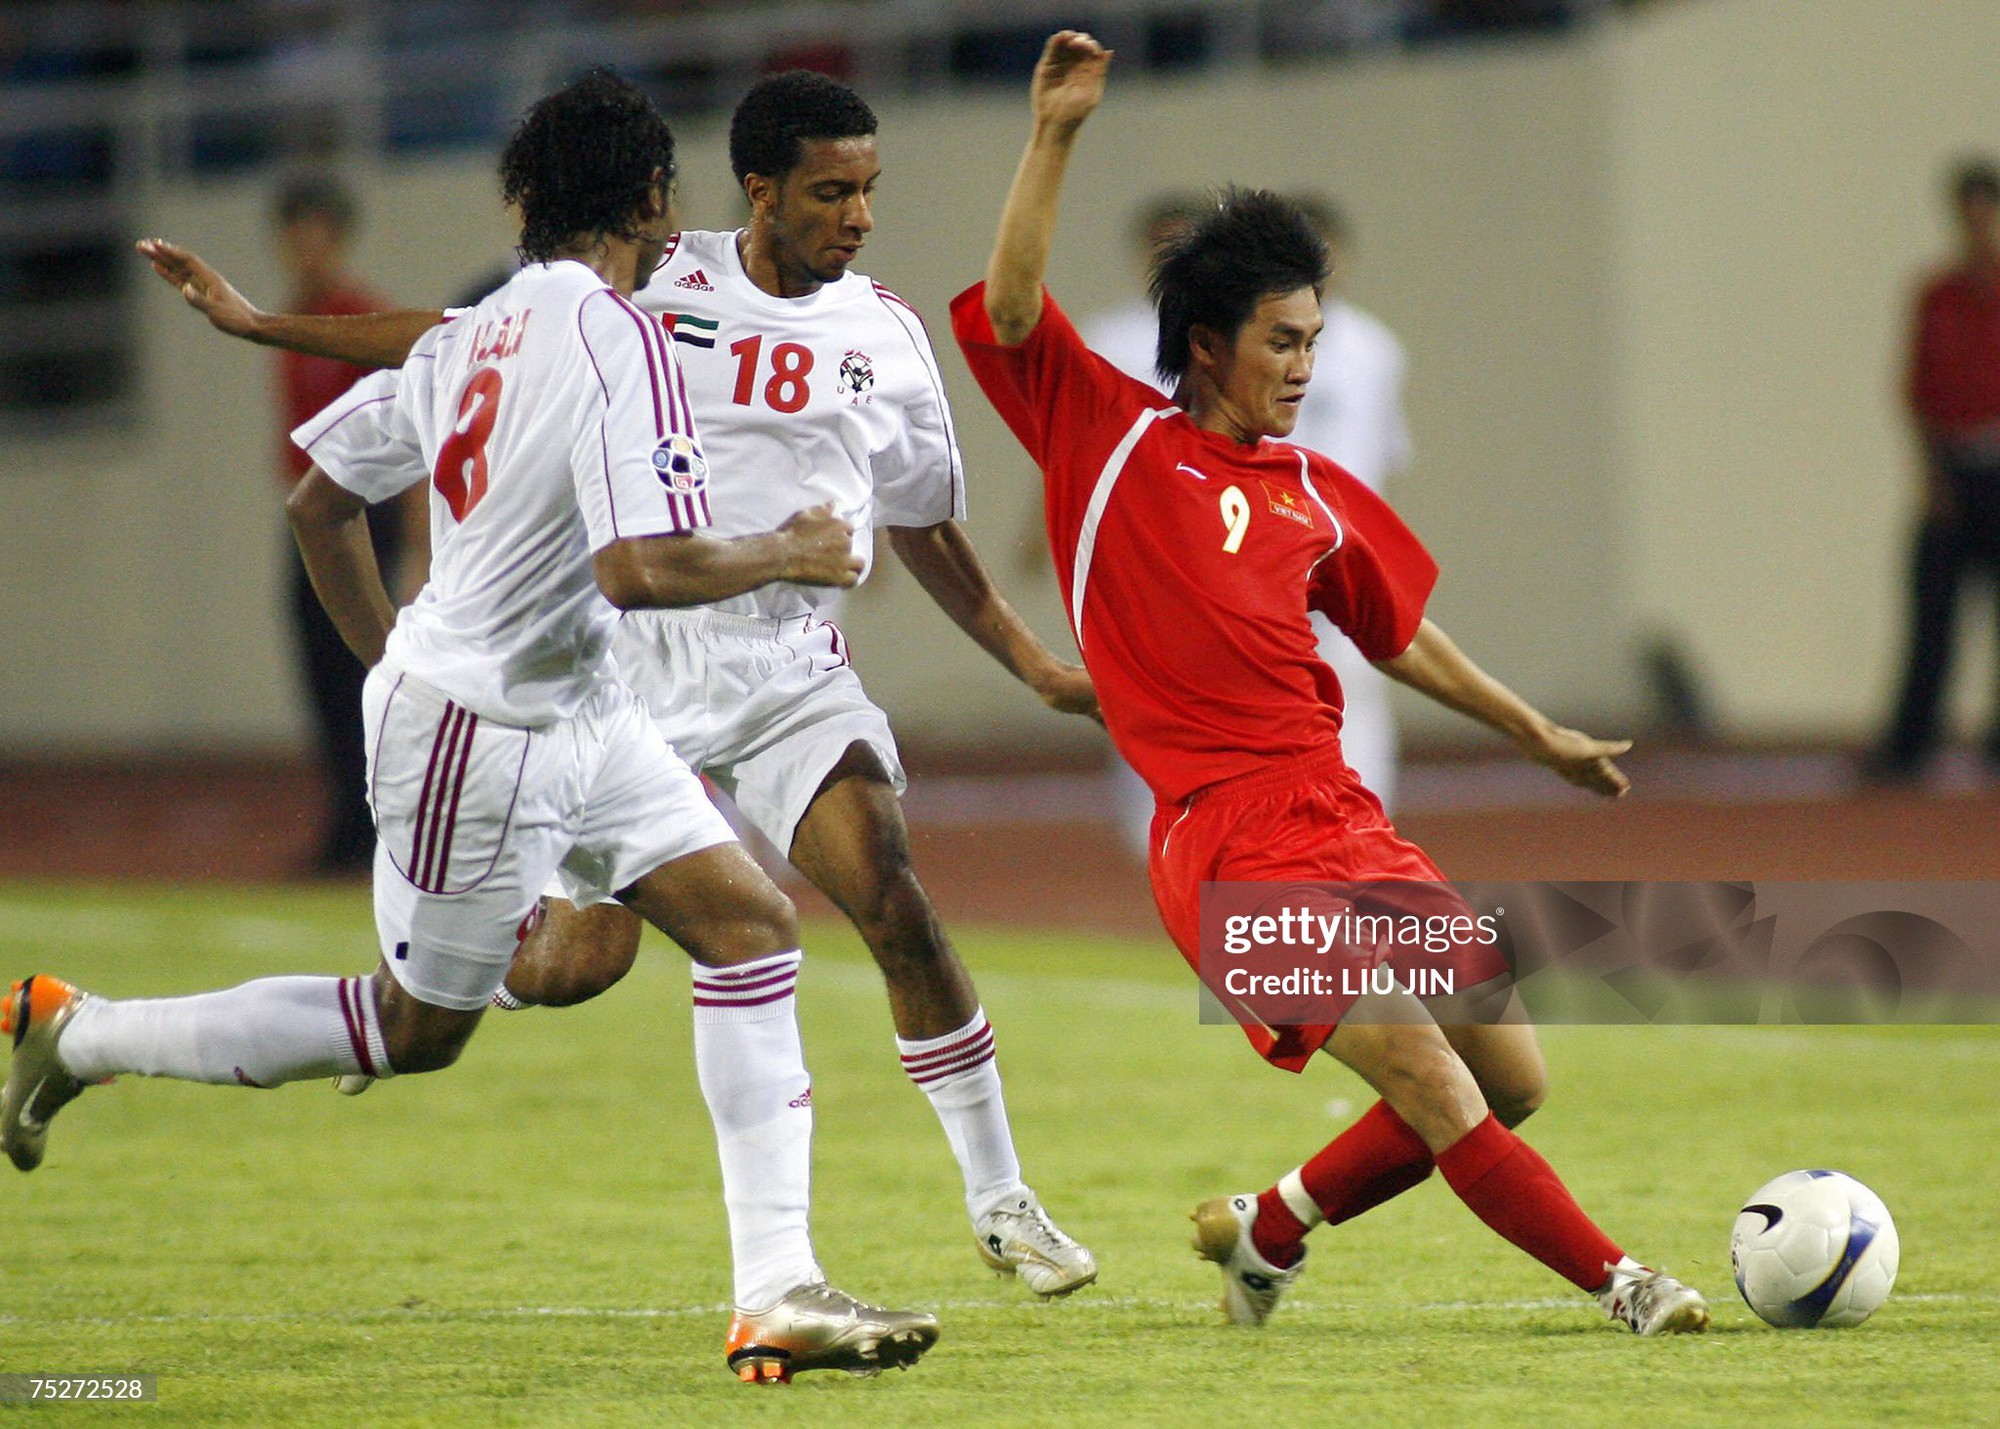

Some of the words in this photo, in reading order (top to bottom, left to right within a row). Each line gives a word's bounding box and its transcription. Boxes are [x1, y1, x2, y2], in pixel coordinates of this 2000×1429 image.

[674, 280, 715, 292] adidas
[730, 334, 814, 413] 18
[434, 366, 503, 524] 8
[1219, 484, 1250, 555] 9
